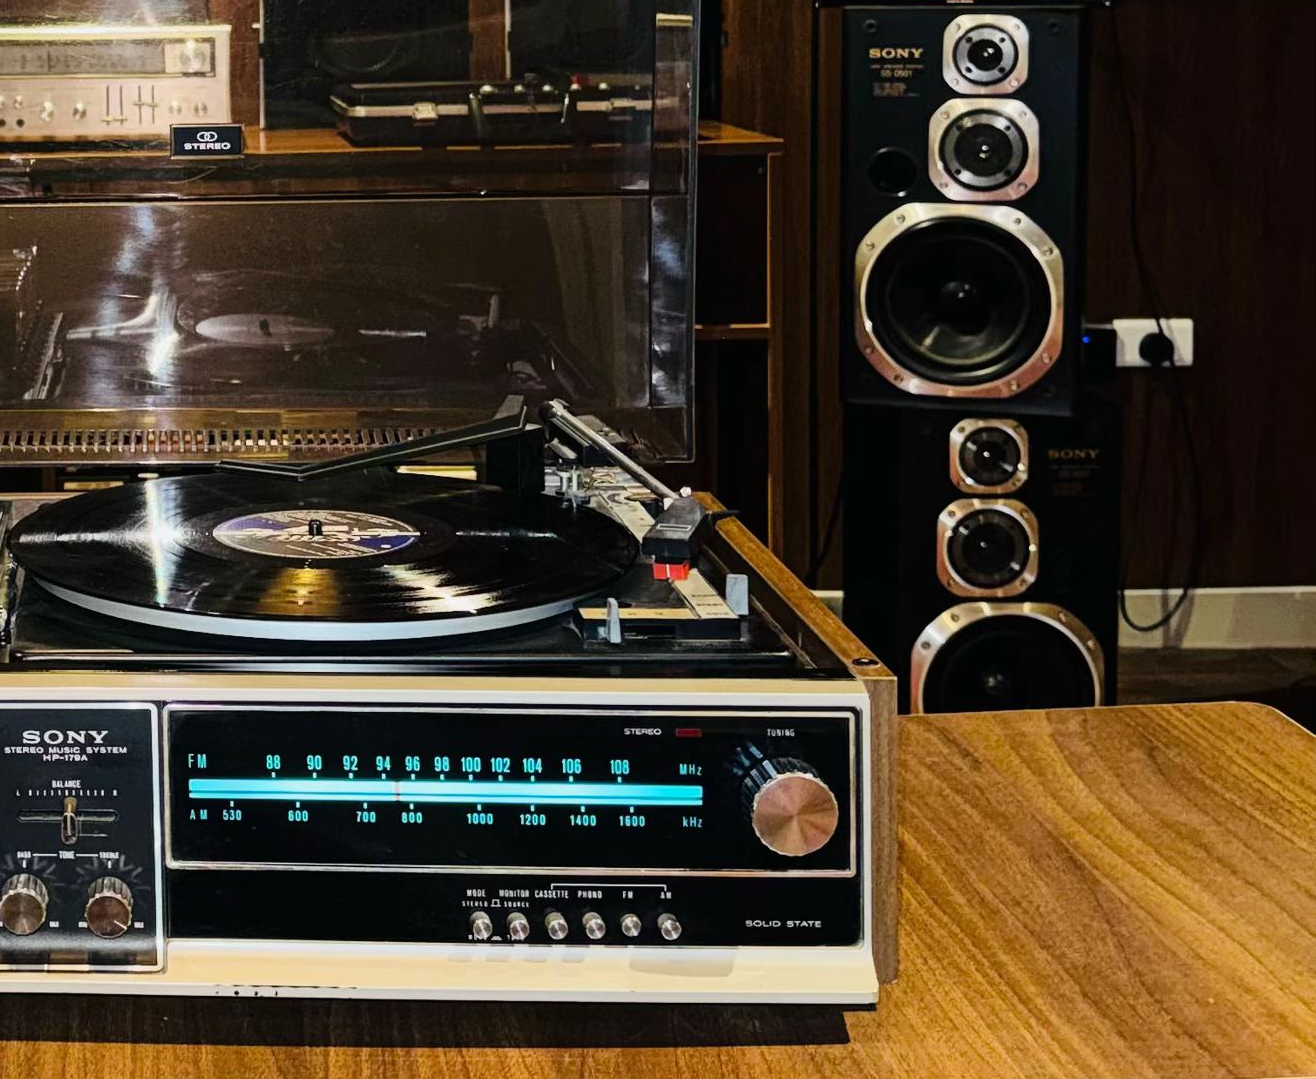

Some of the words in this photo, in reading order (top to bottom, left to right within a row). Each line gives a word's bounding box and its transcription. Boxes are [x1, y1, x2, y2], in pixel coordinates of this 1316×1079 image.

[869, 48, 924, 59] SONY
[184, 141, 231, 150] STEREO
[1047, 449, 1100, 460] SONY
[22, 730, 108, 744] SONY
[624, 728, 662, 736] STEREO
[767, 729, 795, 737] TUNING
[266, 755, 281, 770] 88
[307, 755, 322, 770] 90
[343, 755, 358, 771] 92
[376, 756, 391, 771] 94
[405, 756, 420, 771] 96
[435, 757, 450, 772] 98
[461, 757, 481, 772] 100
[491, 758, 510, 773] 102
[523, 758, 542, 773] 104
[562, 758, 581, 774] 106
[610, 759, 629, 774] 108
[679, 764, 702, 776] MHz
[52, 780, 81, 789] BALANCE
[222, 809, 242, 821] 530
[288, 810, 308, 822] 600
[356, 811, 376, 823] 700
[402, 812, 422, 823] 800
[467, 813, 493, 825] 1000
[520, 814, 546, 826] 1200
[570, 814, 596, 826] 1400
[619, 815, 645, 827] 1600
[683, 816, 703, 828] kHz
[466, 889, 486, 898] MODE
[499, 889, 530, 898] MONITOR
[534, 890, 569, 899] CASSETTE
[577, 890, 603, 899] PHONO
[622, 890, 634, 899] FM
[660, 890, 672, 899] AM
[786, 920, 821, 928] STATE
